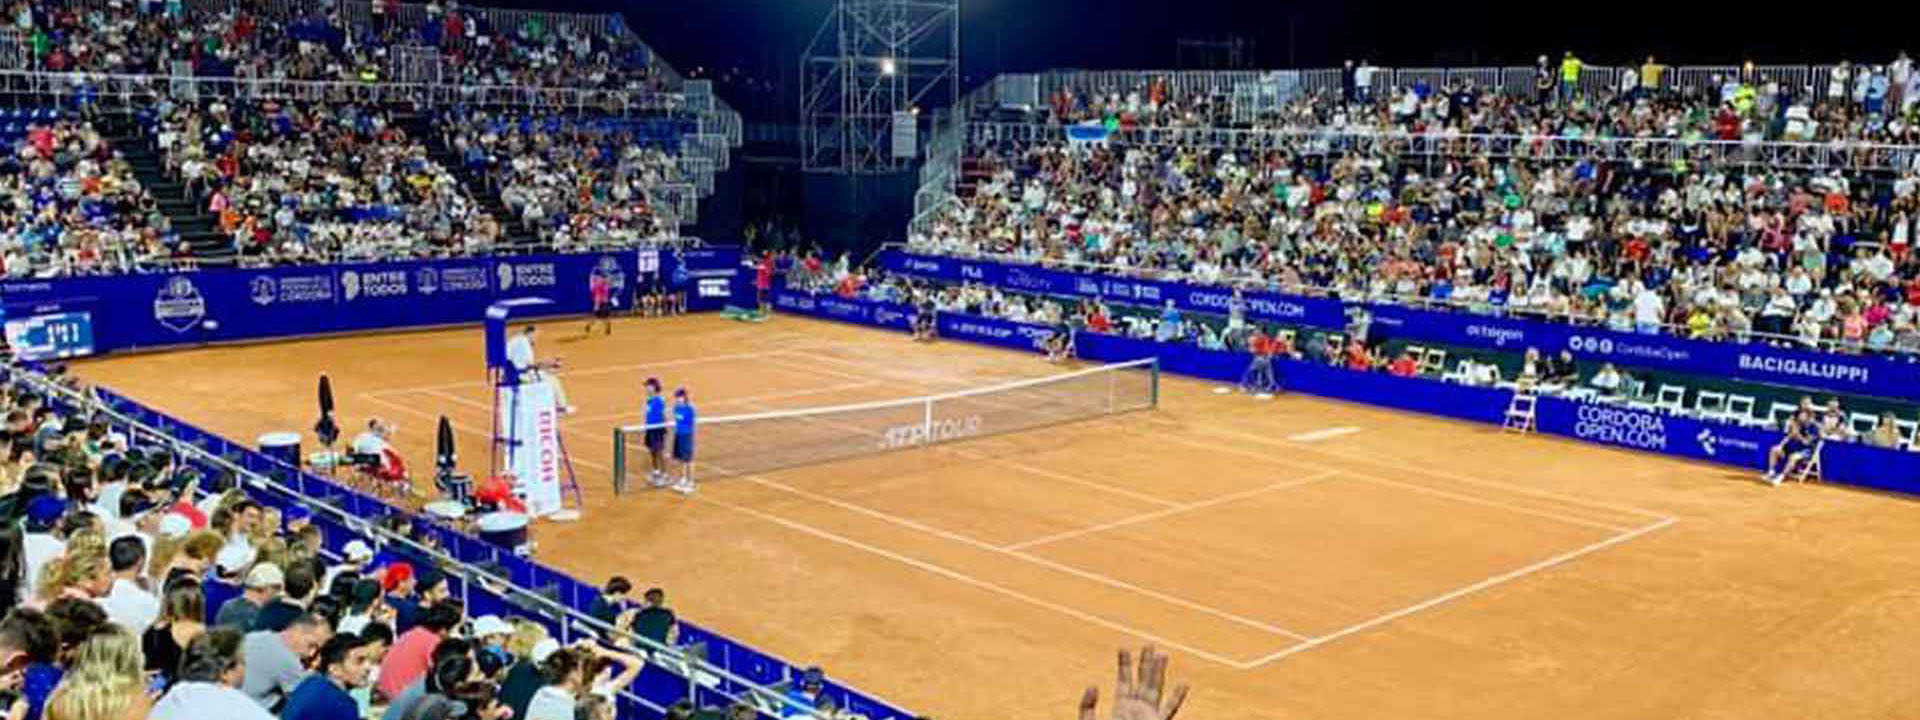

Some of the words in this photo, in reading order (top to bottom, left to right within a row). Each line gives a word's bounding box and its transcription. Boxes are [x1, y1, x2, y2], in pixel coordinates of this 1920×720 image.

[363, 271, 406, 285] ENTRE
[364, 283, 408, 296] TODOS
[1738, 353, 1868, 383] BACIGALUPPI
[1578, 404, 1665, 434] CORDOBA
[1575, 420, 1666, 450] OPEN.COM
